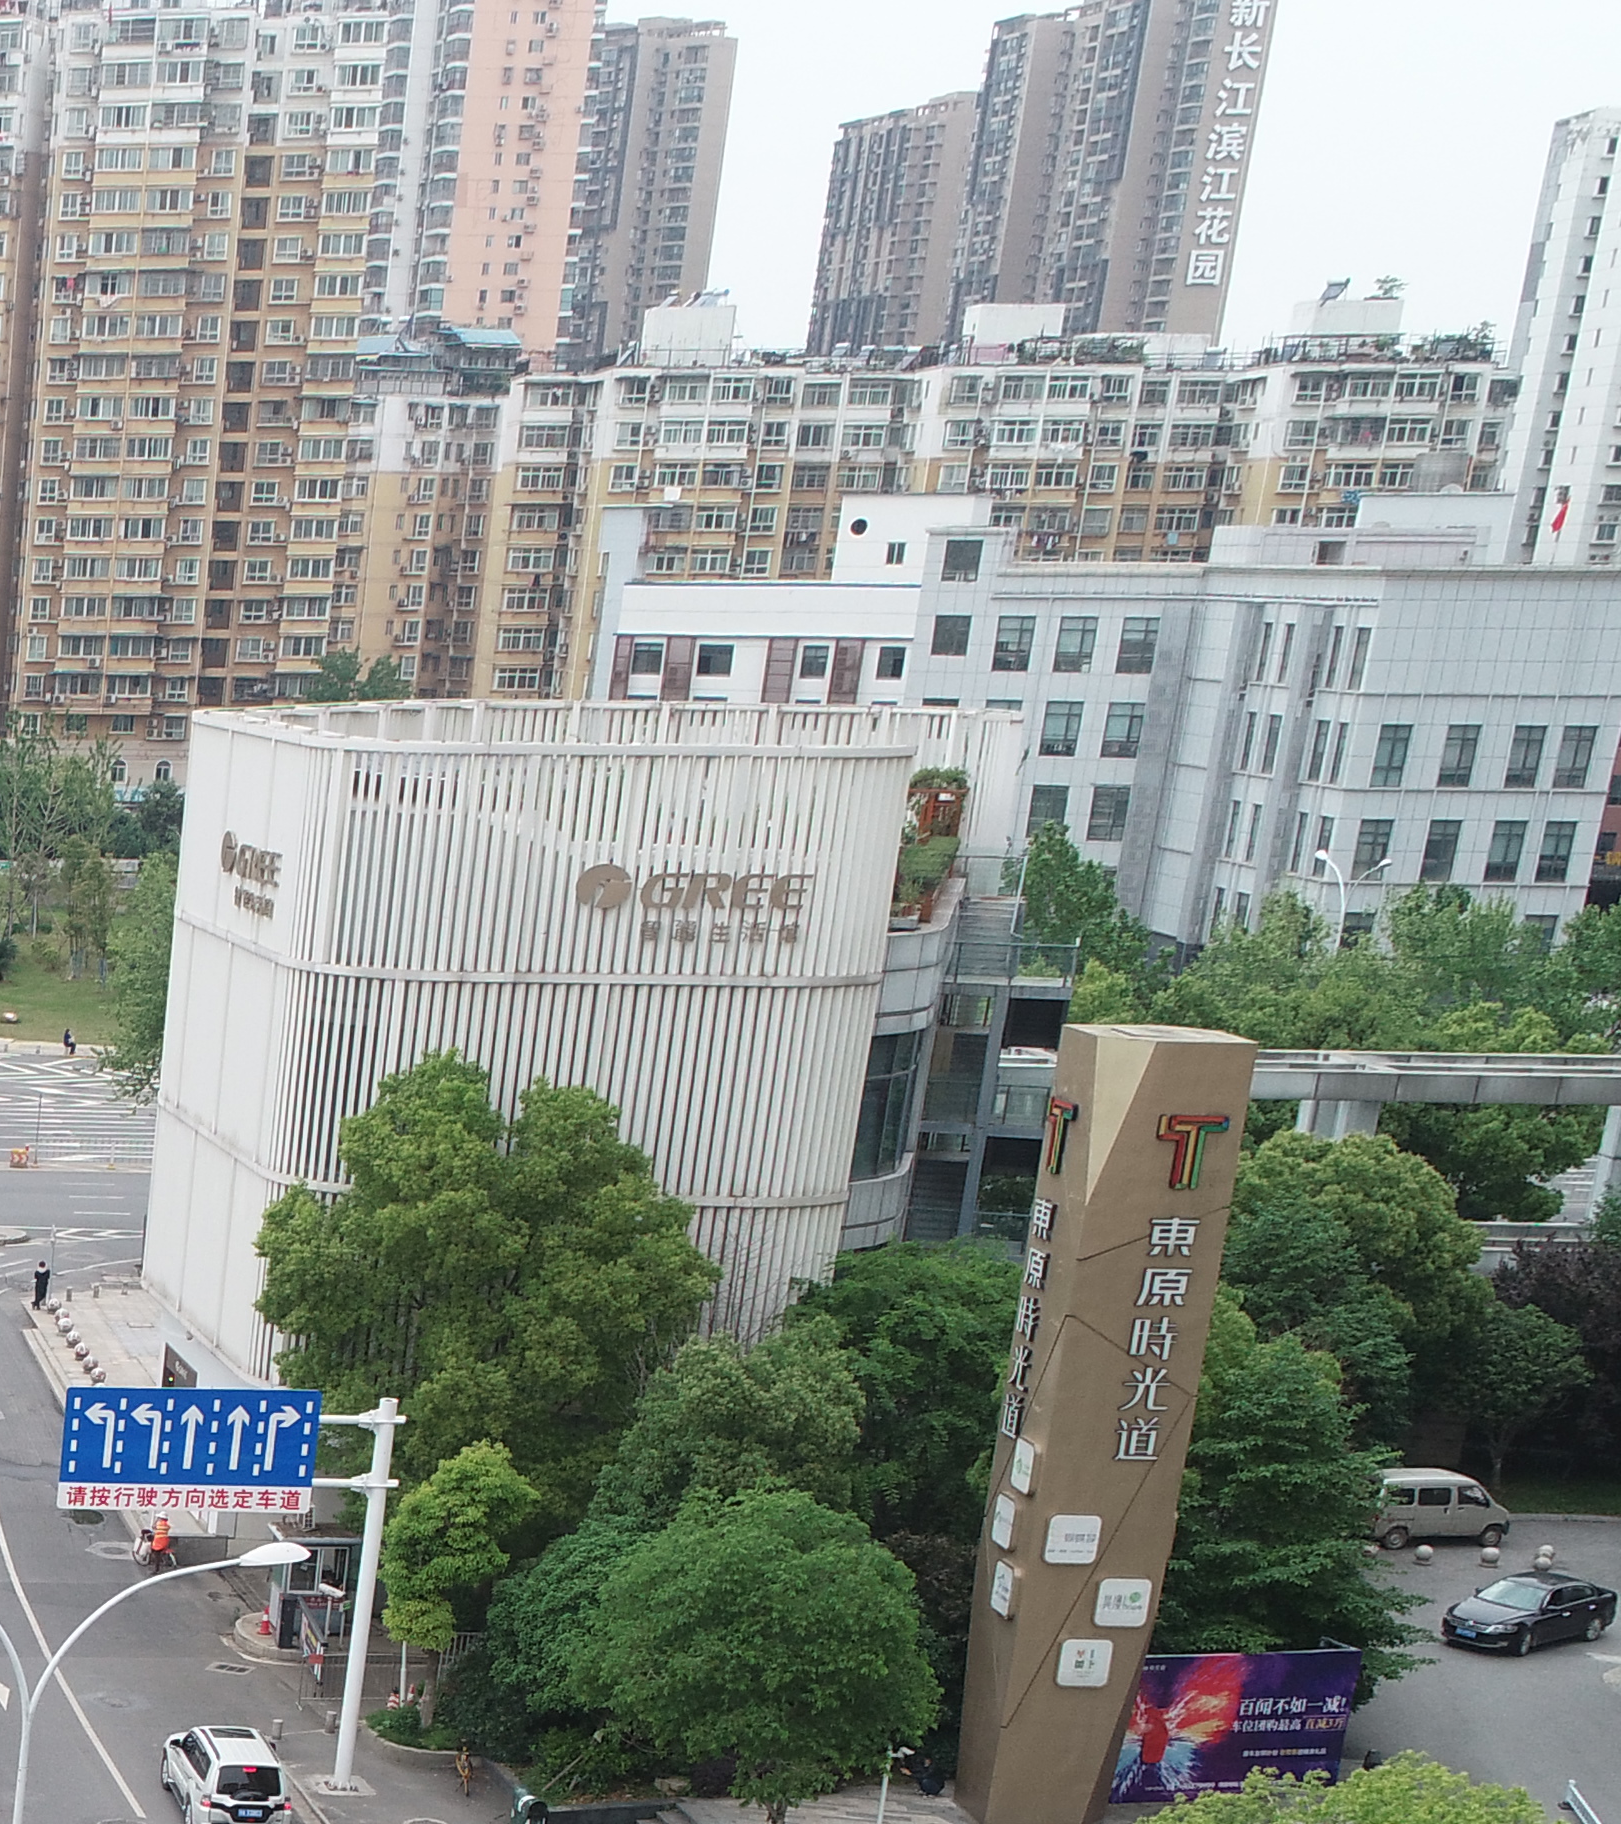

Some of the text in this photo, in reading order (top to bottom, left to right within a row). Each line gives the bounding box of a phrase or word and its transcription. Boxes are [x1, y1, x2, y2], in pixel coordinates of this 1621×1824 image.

[1186, 0, 1269, 286] 新长江滨江花园
[640, 872, 813, 910] GREE
[1001, 1199, 1056, 1440] 東原時光道
[1115, 1217, 1200, 1462] 東原時光道
[66, 1486, 301, 1511] 请按行驶方向选定车道
